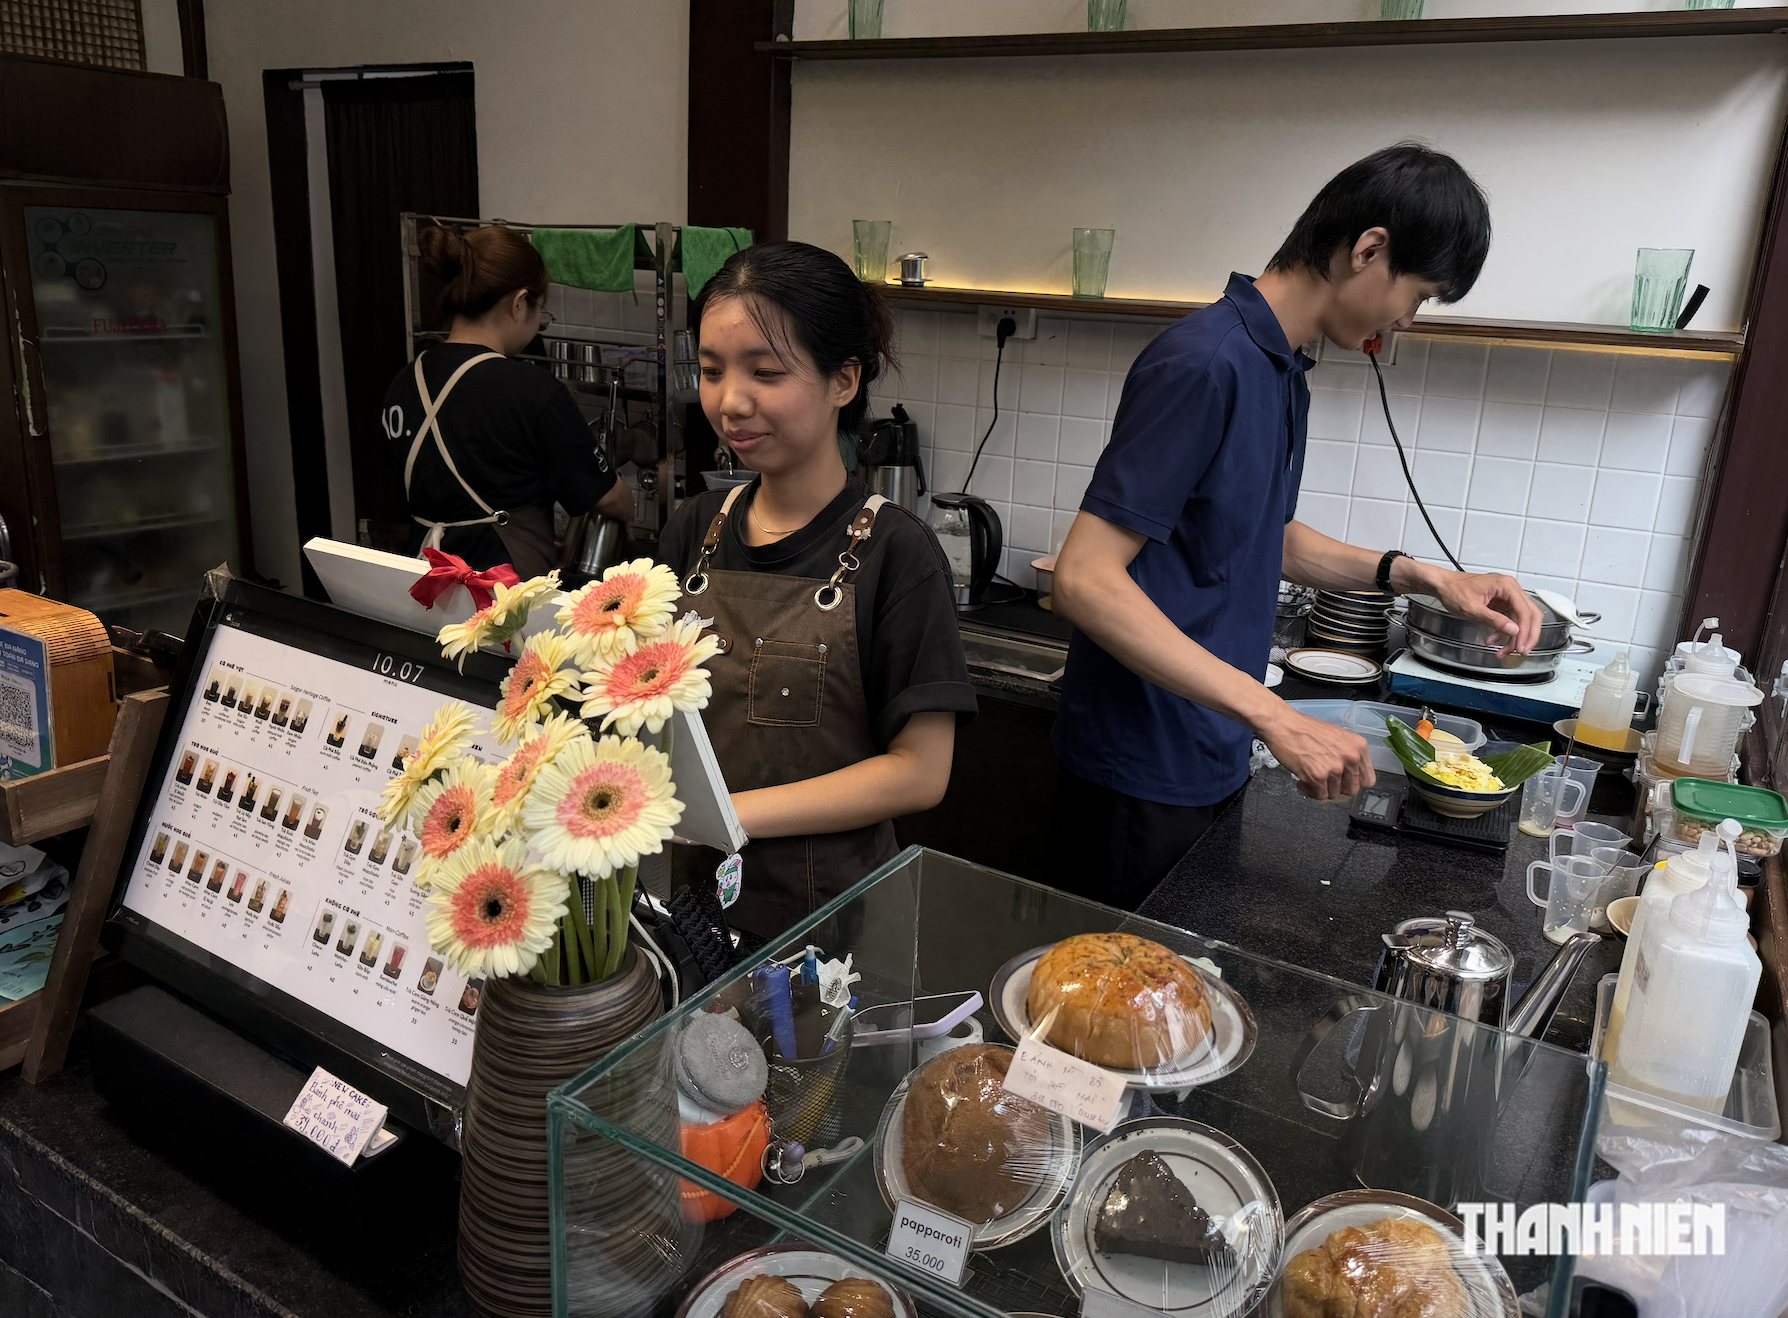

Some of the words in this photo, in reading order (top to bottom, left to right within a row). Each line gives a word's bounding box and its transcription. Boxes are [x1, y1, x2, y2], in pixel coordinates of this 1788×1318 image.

[71, 241, 177, 255] INVERTER
[372, 653, 424, 682] 10.07
[289, 684, 302, 692] Saigon
[302, 689, 318, 698] Heritage
[318, 694, 331, 702] Coffee
[268, 871, 279, 879] Fresh
[278, 876, 291, 885] Juices
[325, 897, 342, 909] KHÔNG
[350, 908, 360, 917] PHÊ
[385, 926, 409, 940] Non-Coffee
[309, 1081, 328, 1102] Bánh
[327, 1095, 343, 1109] phô
[343, 1107, 361, 1121] mai
[331, 1080, 349, 1094] NEW
[349, 1090, 368, 1106] CAKE
[313, 1111, 338, 1133] chanh
[900, 1216, 962, 1248] papparoti
[904, 1246, 945, 1271] 35.000
